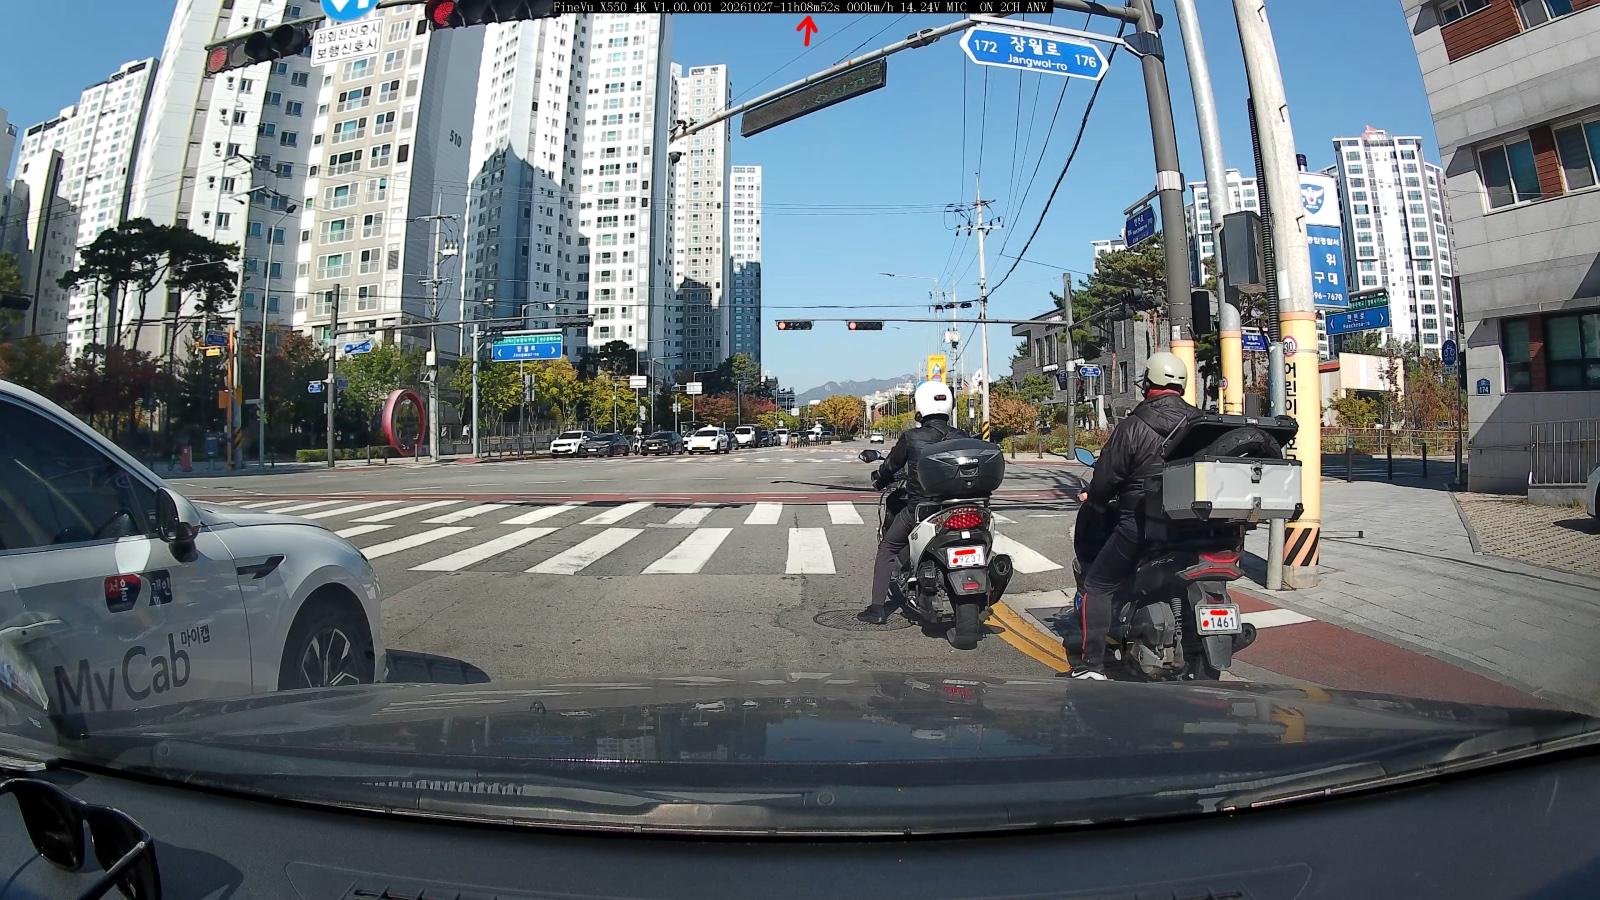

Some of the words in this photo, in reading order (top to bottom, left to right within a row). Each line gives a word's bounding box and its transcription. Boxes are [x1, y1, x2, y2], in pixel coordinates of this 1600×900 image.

[316, 37, 378, 60] 보행신호시
[974, 39, 998, 53] 172
[1010, 36, 1061, 56] 장월로
[1008, 54, 1068, 71] Jangwol-ro
[1074, 54, 1097, 68] 176
[449, 129, 462, 148] 510
[1284, 341, 1294, 353] 30
[1285, 362, 1297, 415] 어린이
[1210, 617, 1235, 629] 1461
[180, 623, 211, 647] 마이캡
[121, 632, 191, 701] Cab
